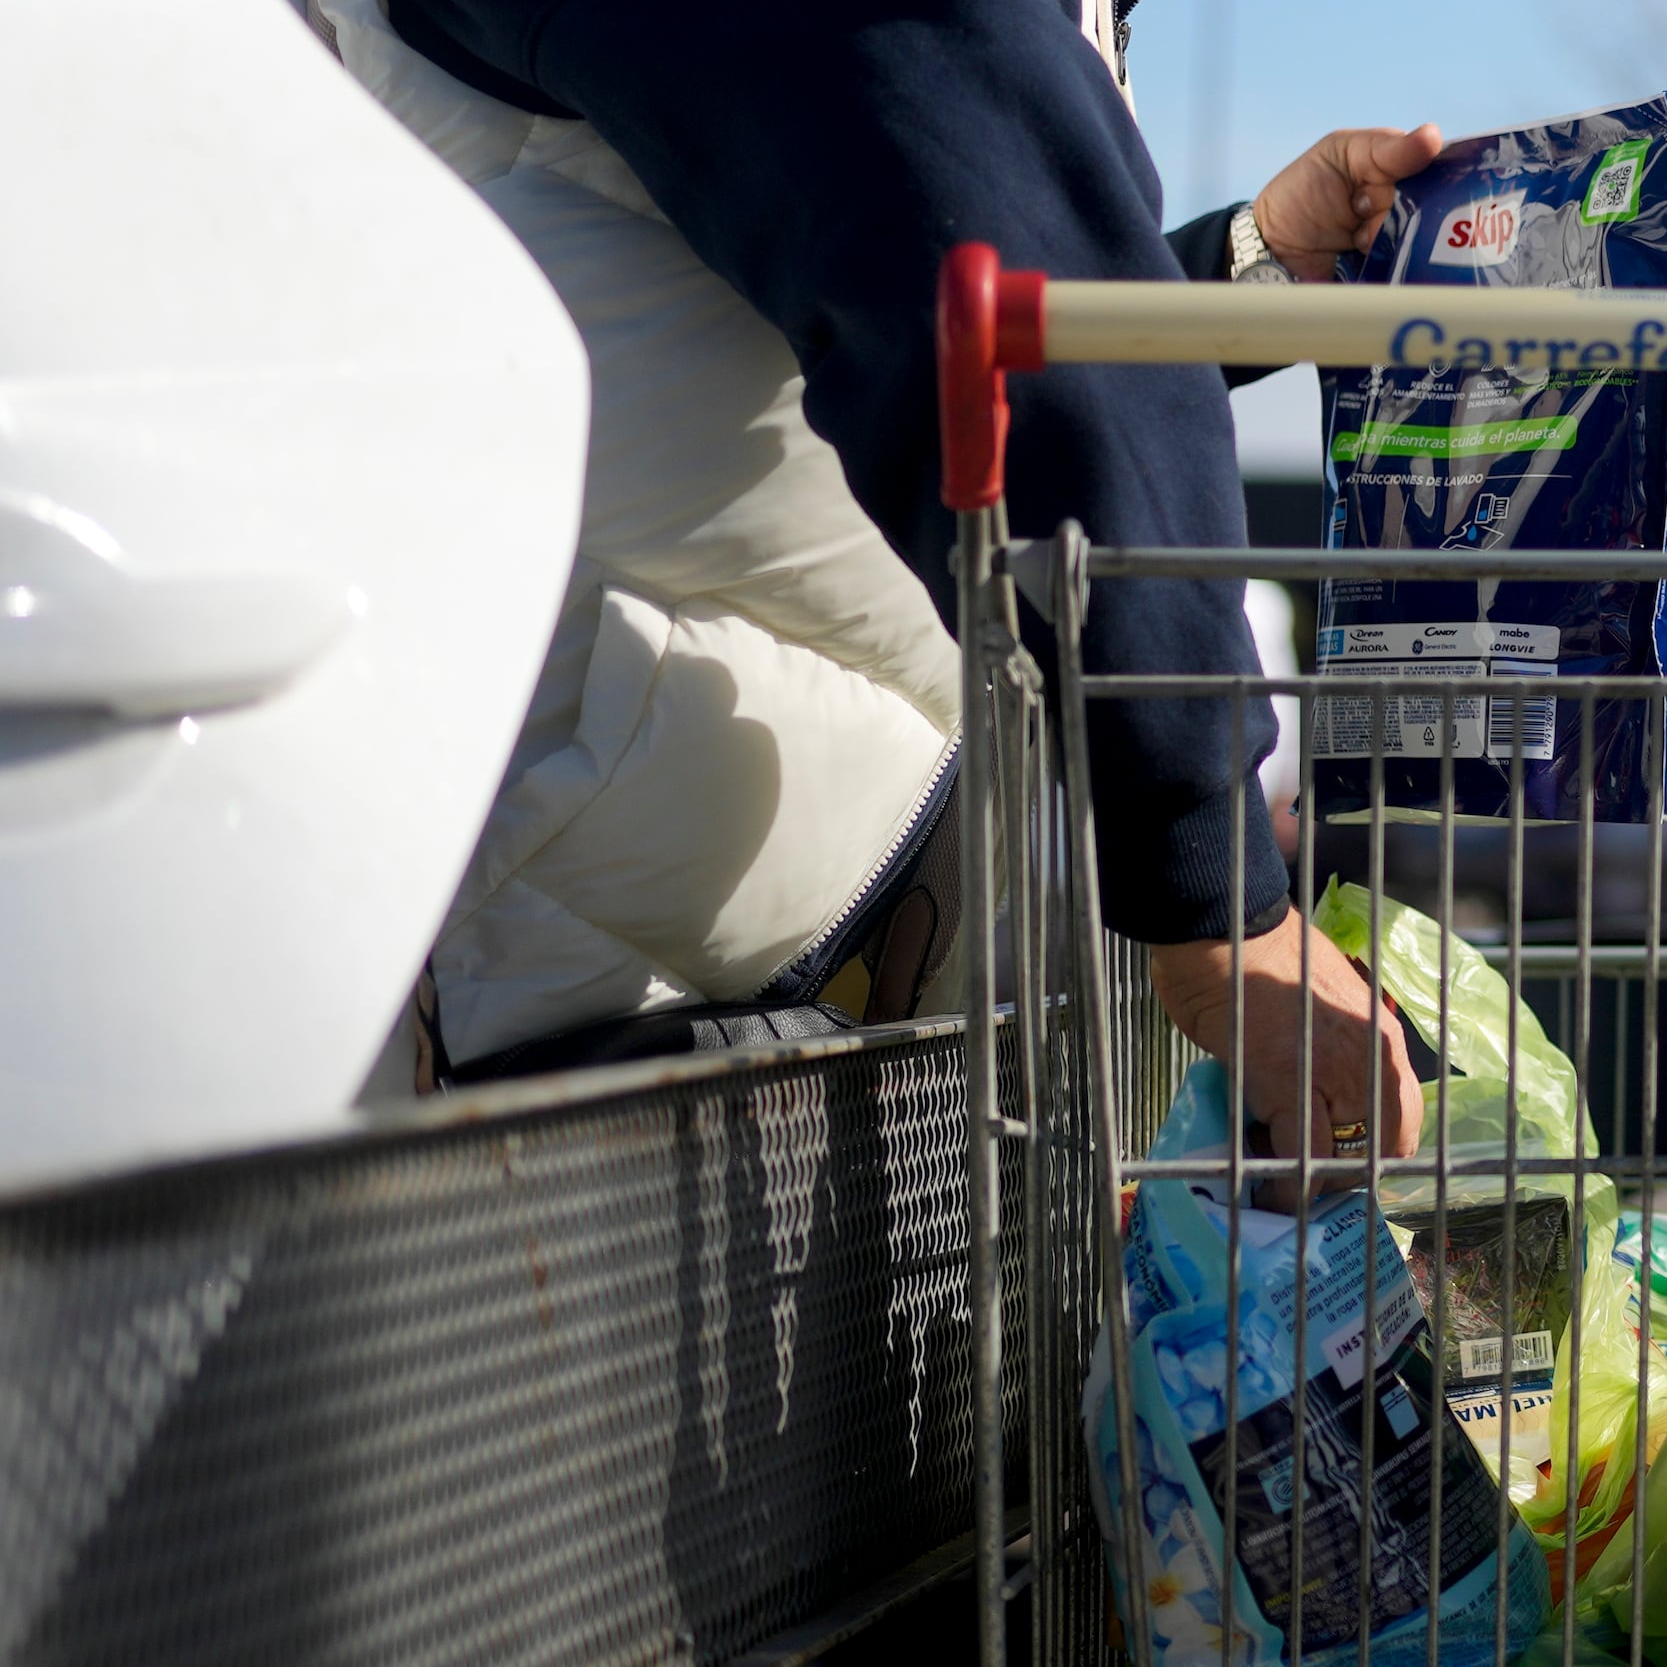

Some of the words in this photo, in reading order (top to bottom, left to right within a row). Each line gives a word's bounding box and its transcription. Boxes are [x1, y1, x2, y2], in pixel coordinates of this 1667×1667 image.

[1447, 203, 1514, 255] skip
[1380, 432, 1447, 450] mientras
[1449, 431, 1485, 448] cuida
[1488, 431, 1501, 444] el
[1504, 428, 1561, 450] planeta.
[1346, 473, 1424, 487] STRUCCIONES
[1426, 475, 1442, 487] DE
[1443, 473, 1485, 487] LAVADO
[1353, 629, 1384, 639] Drean
[1499, 628, 1530, 639] mabe
[1348, 644, 1389, 653] AURORA
[1489, 644, 1536, 654] LONGVIE
[1454, 1395, 1552, 1422] HELMA
